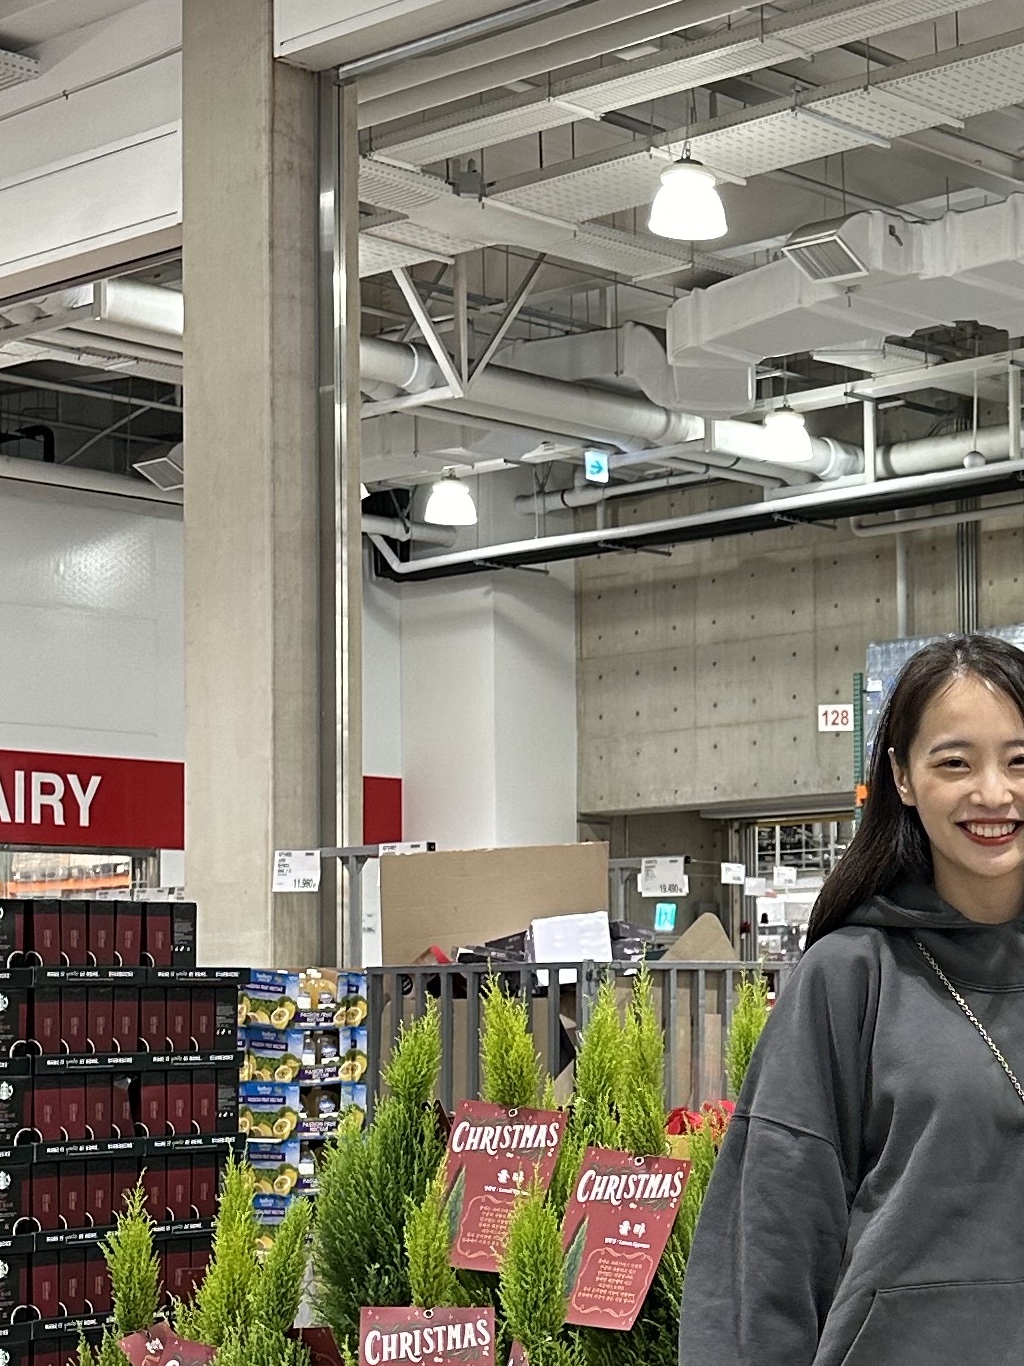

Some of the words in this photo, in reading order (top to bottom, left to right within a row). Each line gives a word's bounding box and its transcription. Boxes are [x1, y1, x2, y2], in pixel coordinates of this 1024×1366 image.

[822, 710, 849, 726] 128
[452, 1121, 559, 1155] CHRISTMAS
[577, 1169, 683, 1206] CHRISTMAS
[364, 1319, 491, 1366] CHRISTMAS
